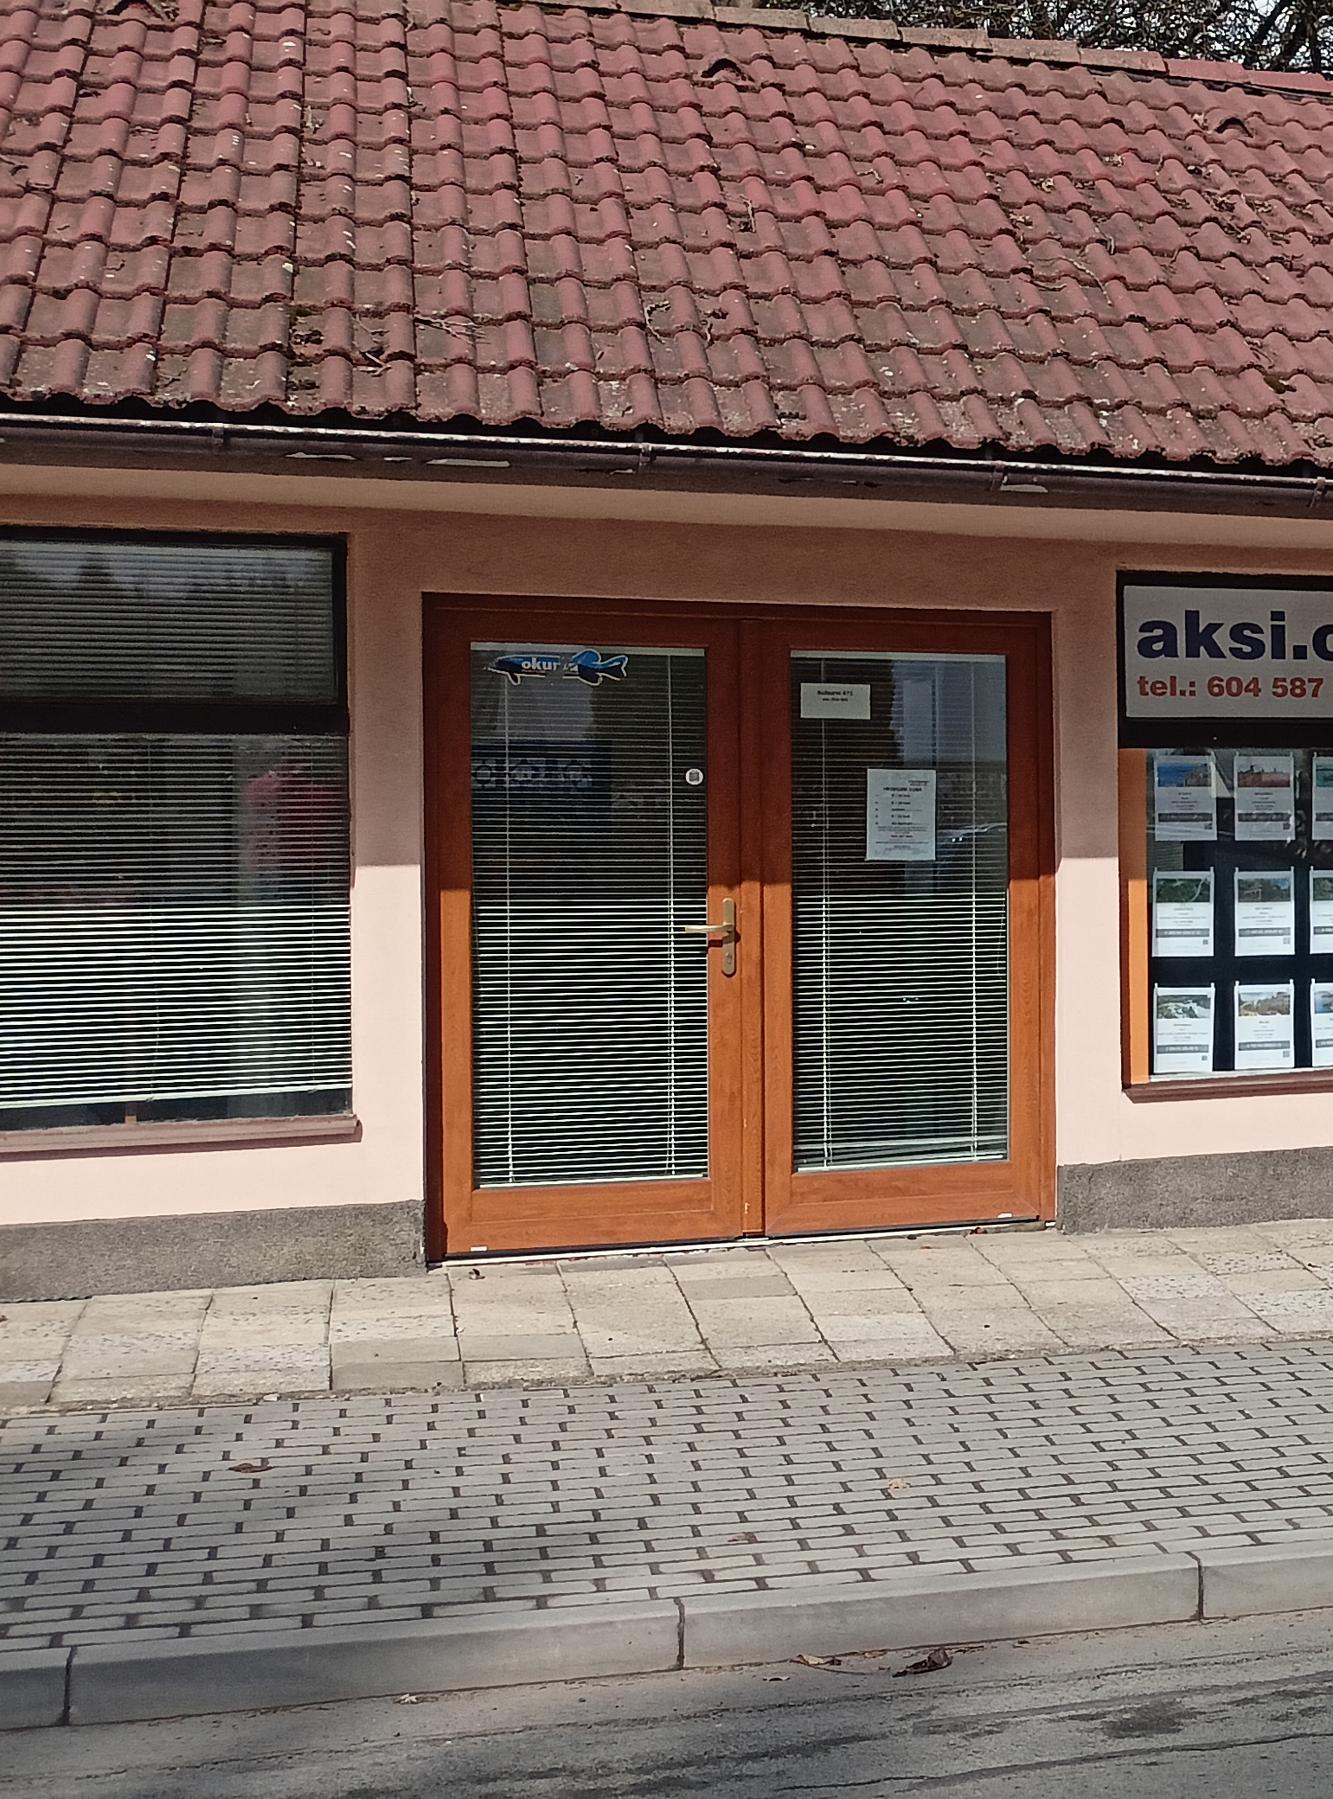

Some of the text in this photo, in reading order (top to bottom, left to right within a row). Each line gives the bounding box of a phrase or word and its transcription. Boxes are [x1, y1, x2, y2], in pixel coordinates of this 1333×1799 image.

[1137, 675, 1197, 697] tel.:
[1206, 675, 1262, 698] 604
[1271, 676, 1324, 698] 587
